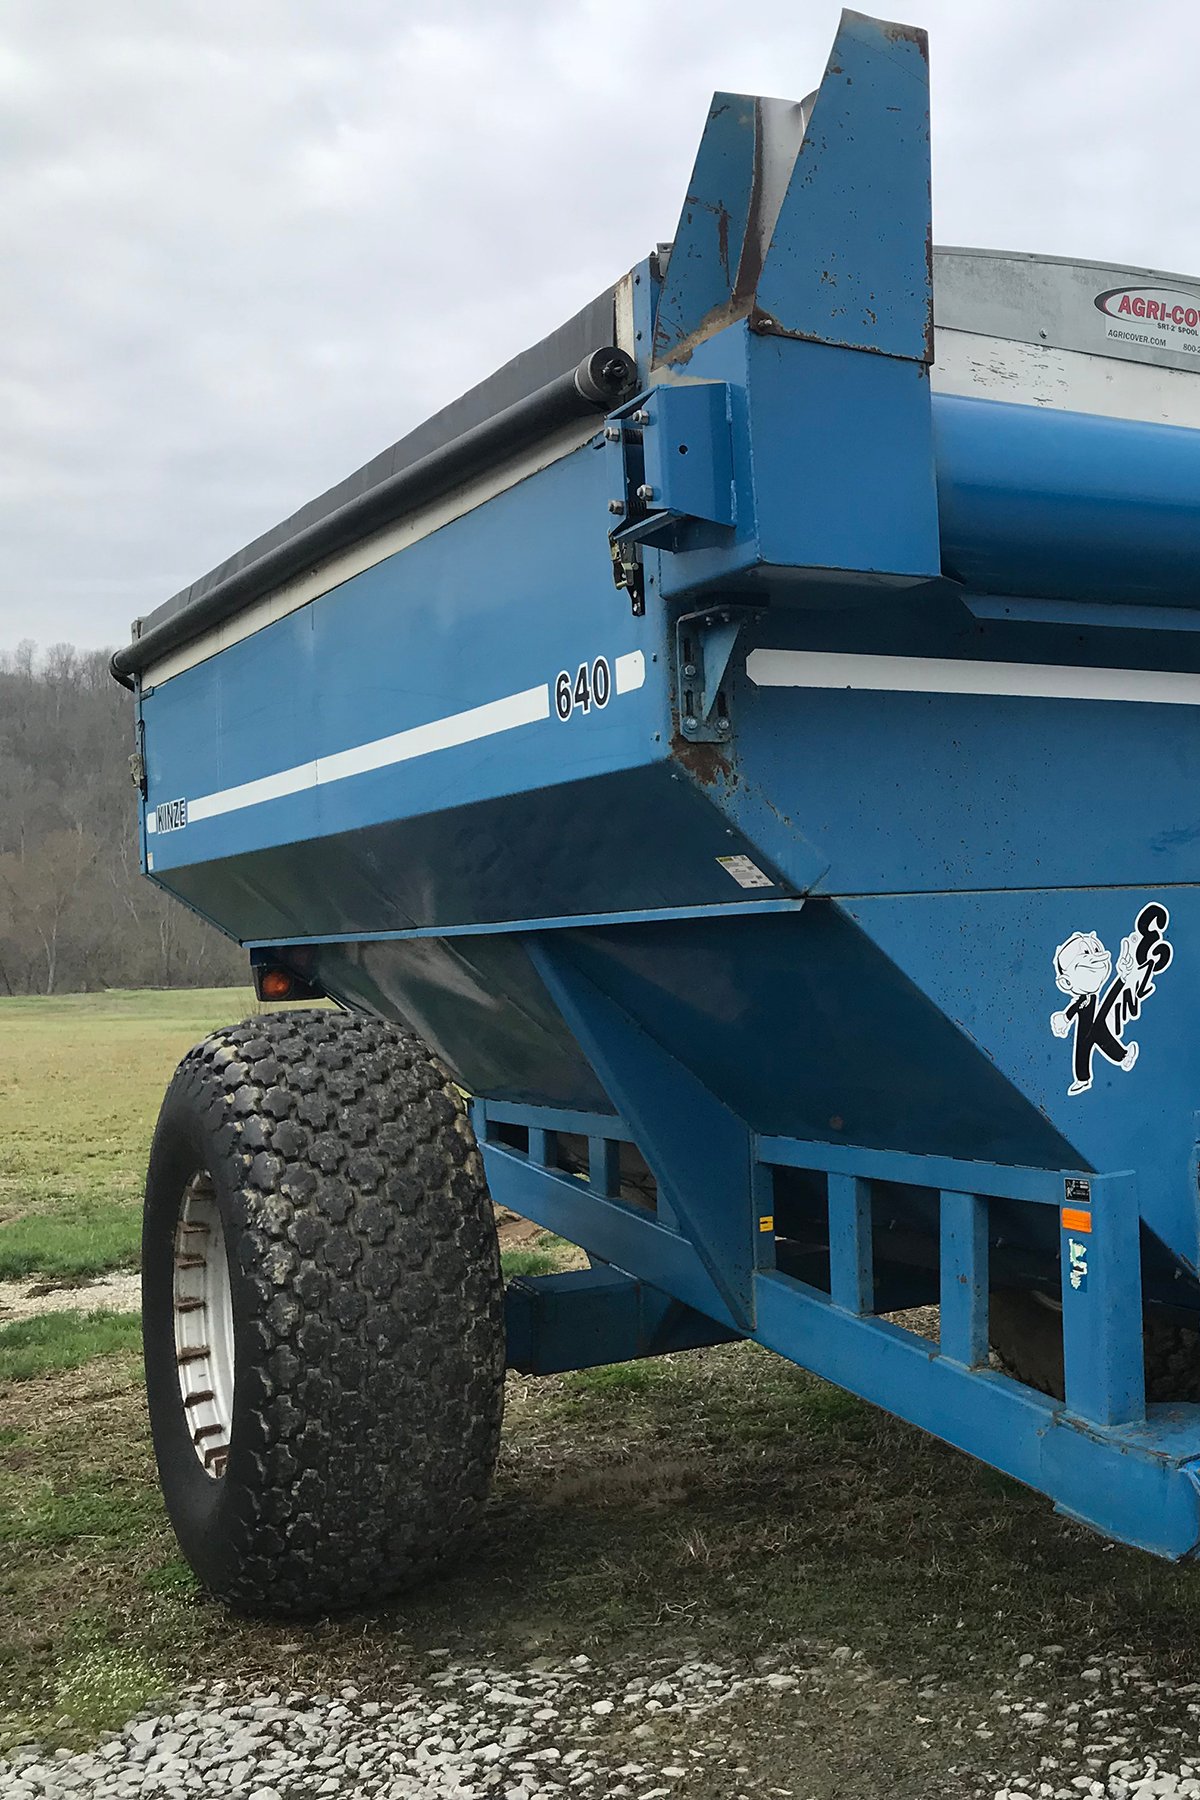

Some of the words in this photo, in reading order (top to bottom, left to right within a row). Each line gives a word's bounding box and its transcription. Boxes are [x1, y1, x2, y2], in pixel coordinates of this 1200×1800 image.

[1107, 329, 1167, 347] AGRICOVER.COM
[1178, 326, 1199, 337] SPOOL
[555, 656, 611, 722] 640
[157, 798, 186, 834] KINZE
